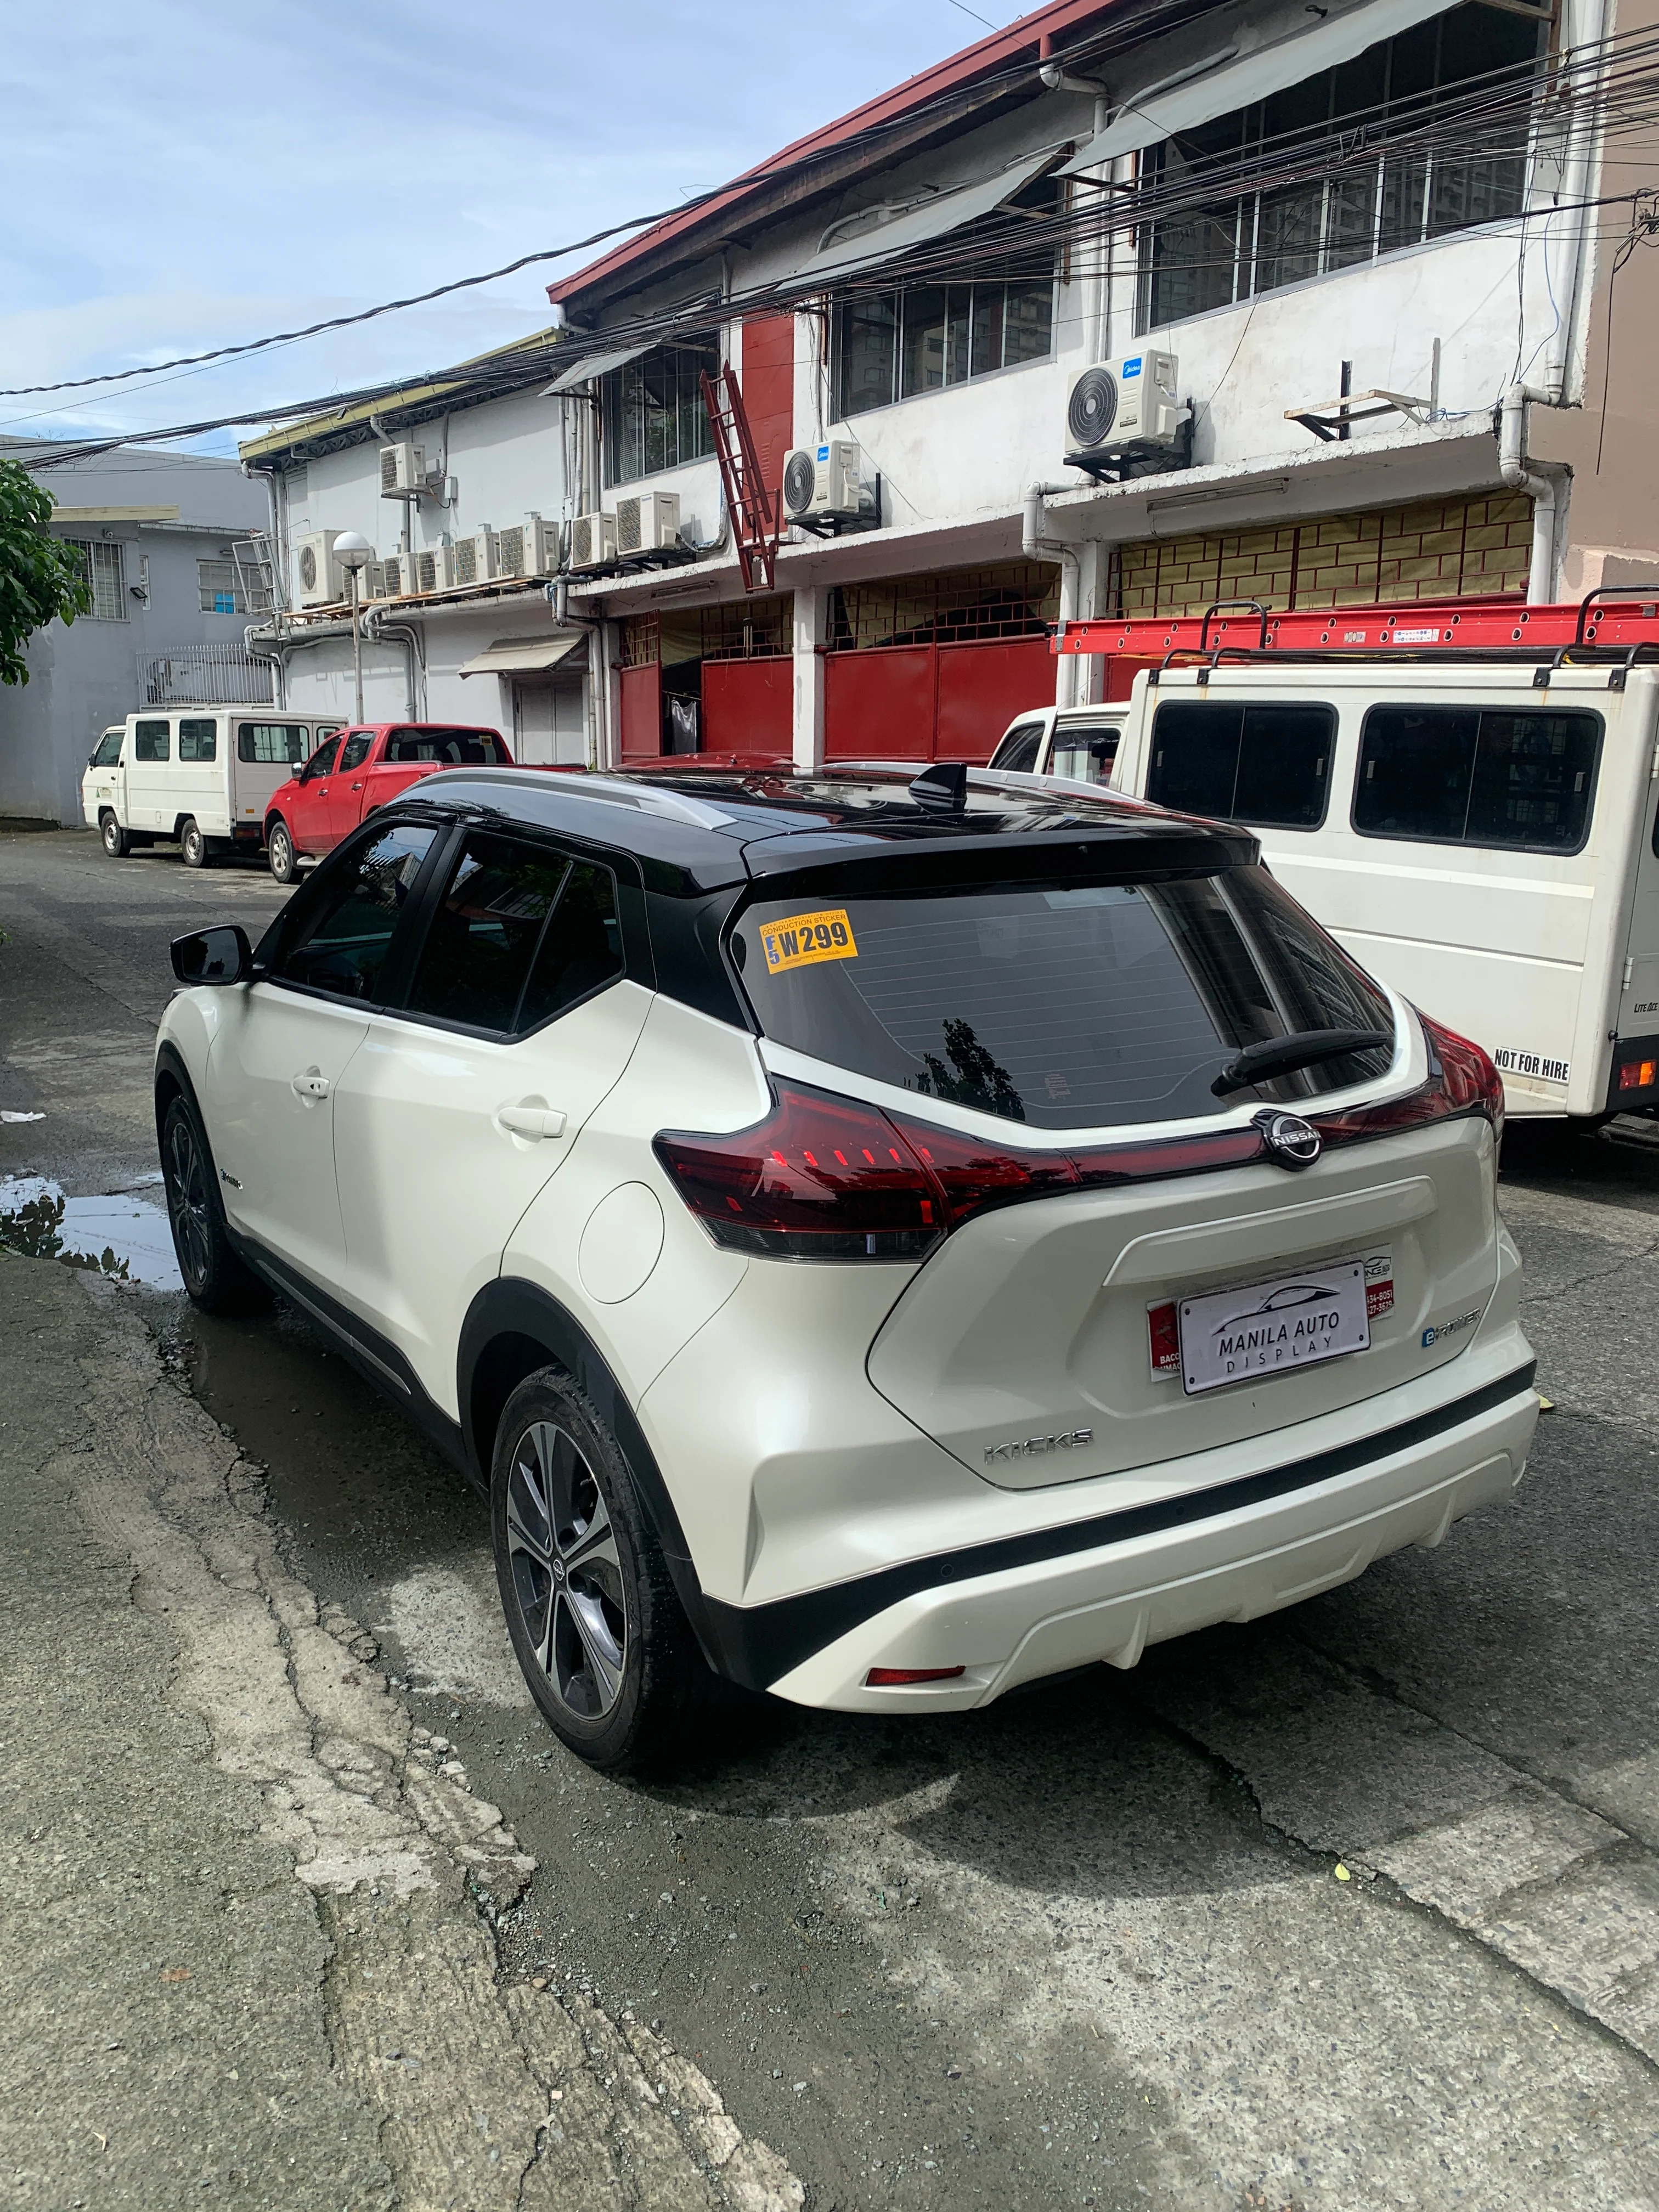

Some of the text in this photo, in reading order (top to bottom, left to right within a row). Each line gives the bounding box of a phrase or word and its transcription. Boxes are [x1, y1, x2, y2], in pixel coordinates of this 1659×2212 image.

[1125, 365, 1140, 374] Midea
[762, 914, 847, 936] CONDUCTION STICKER
[778, 922, 848, 957] W299
[1494, 1048, 1570, 1081] NOT FOR HIRE
[1273, 1131, 1321, 1146] NISSAN
[1219, 1311, 1340, 1357] MANILA AUTO
[1227, 1336, 1331, 1373] DISPLAY
[984, 1428, 1094, 1464] KICKS
